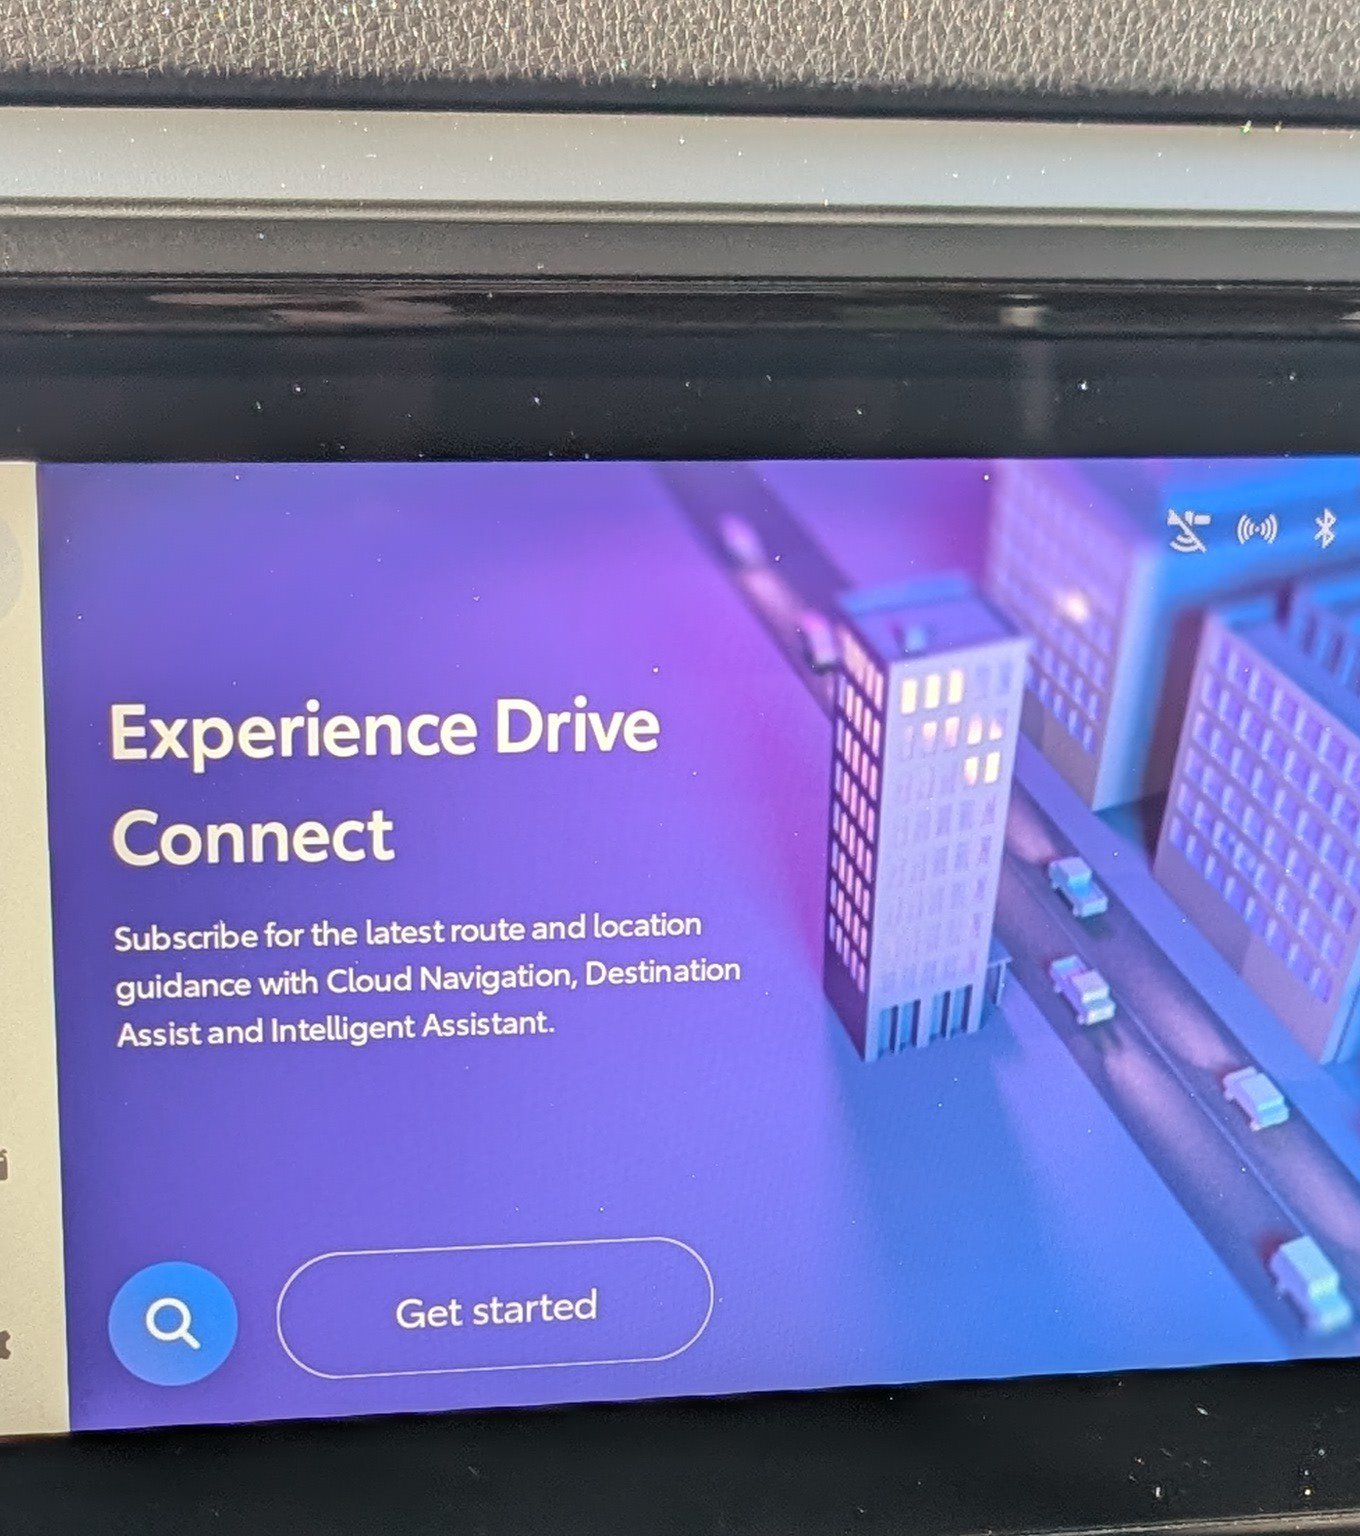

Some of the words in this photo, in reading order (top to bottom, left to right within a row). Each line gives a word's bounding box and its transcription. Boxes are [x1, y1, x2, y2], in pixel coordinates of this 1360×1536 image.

[109, 699, 478, 773] Experience
[496, 695, 661, 753] Drive
[112, 808, 396, 866] Connect
[114, 922, 258, 952] Subscribe
[264, 921, 304, 946] for
[310, 919, 359, 946] the
[365, 918, 444, 945] latest
[451, 918, 525, 942] route
[532, 914, 586, 940] and
[594, 912, 702, 938] location
[115, 974, 251, 1005] guidance
[258, 971, 318, 997] with
[327, 968, 412, 994] Cloud
[420, 964, 578, 999] Navigation,
[586, 957, 741, 986] Destination
[117, 1019, 202, 1048] Assist
[208, 1017, 264, 1044] and
[272, 1014, 415, 1047] Intelligent
[422, 1010, 555, 1037] Assistant.
[395, 1297, 464, 1329] Get
[472, 1288, 598, 1326] started
